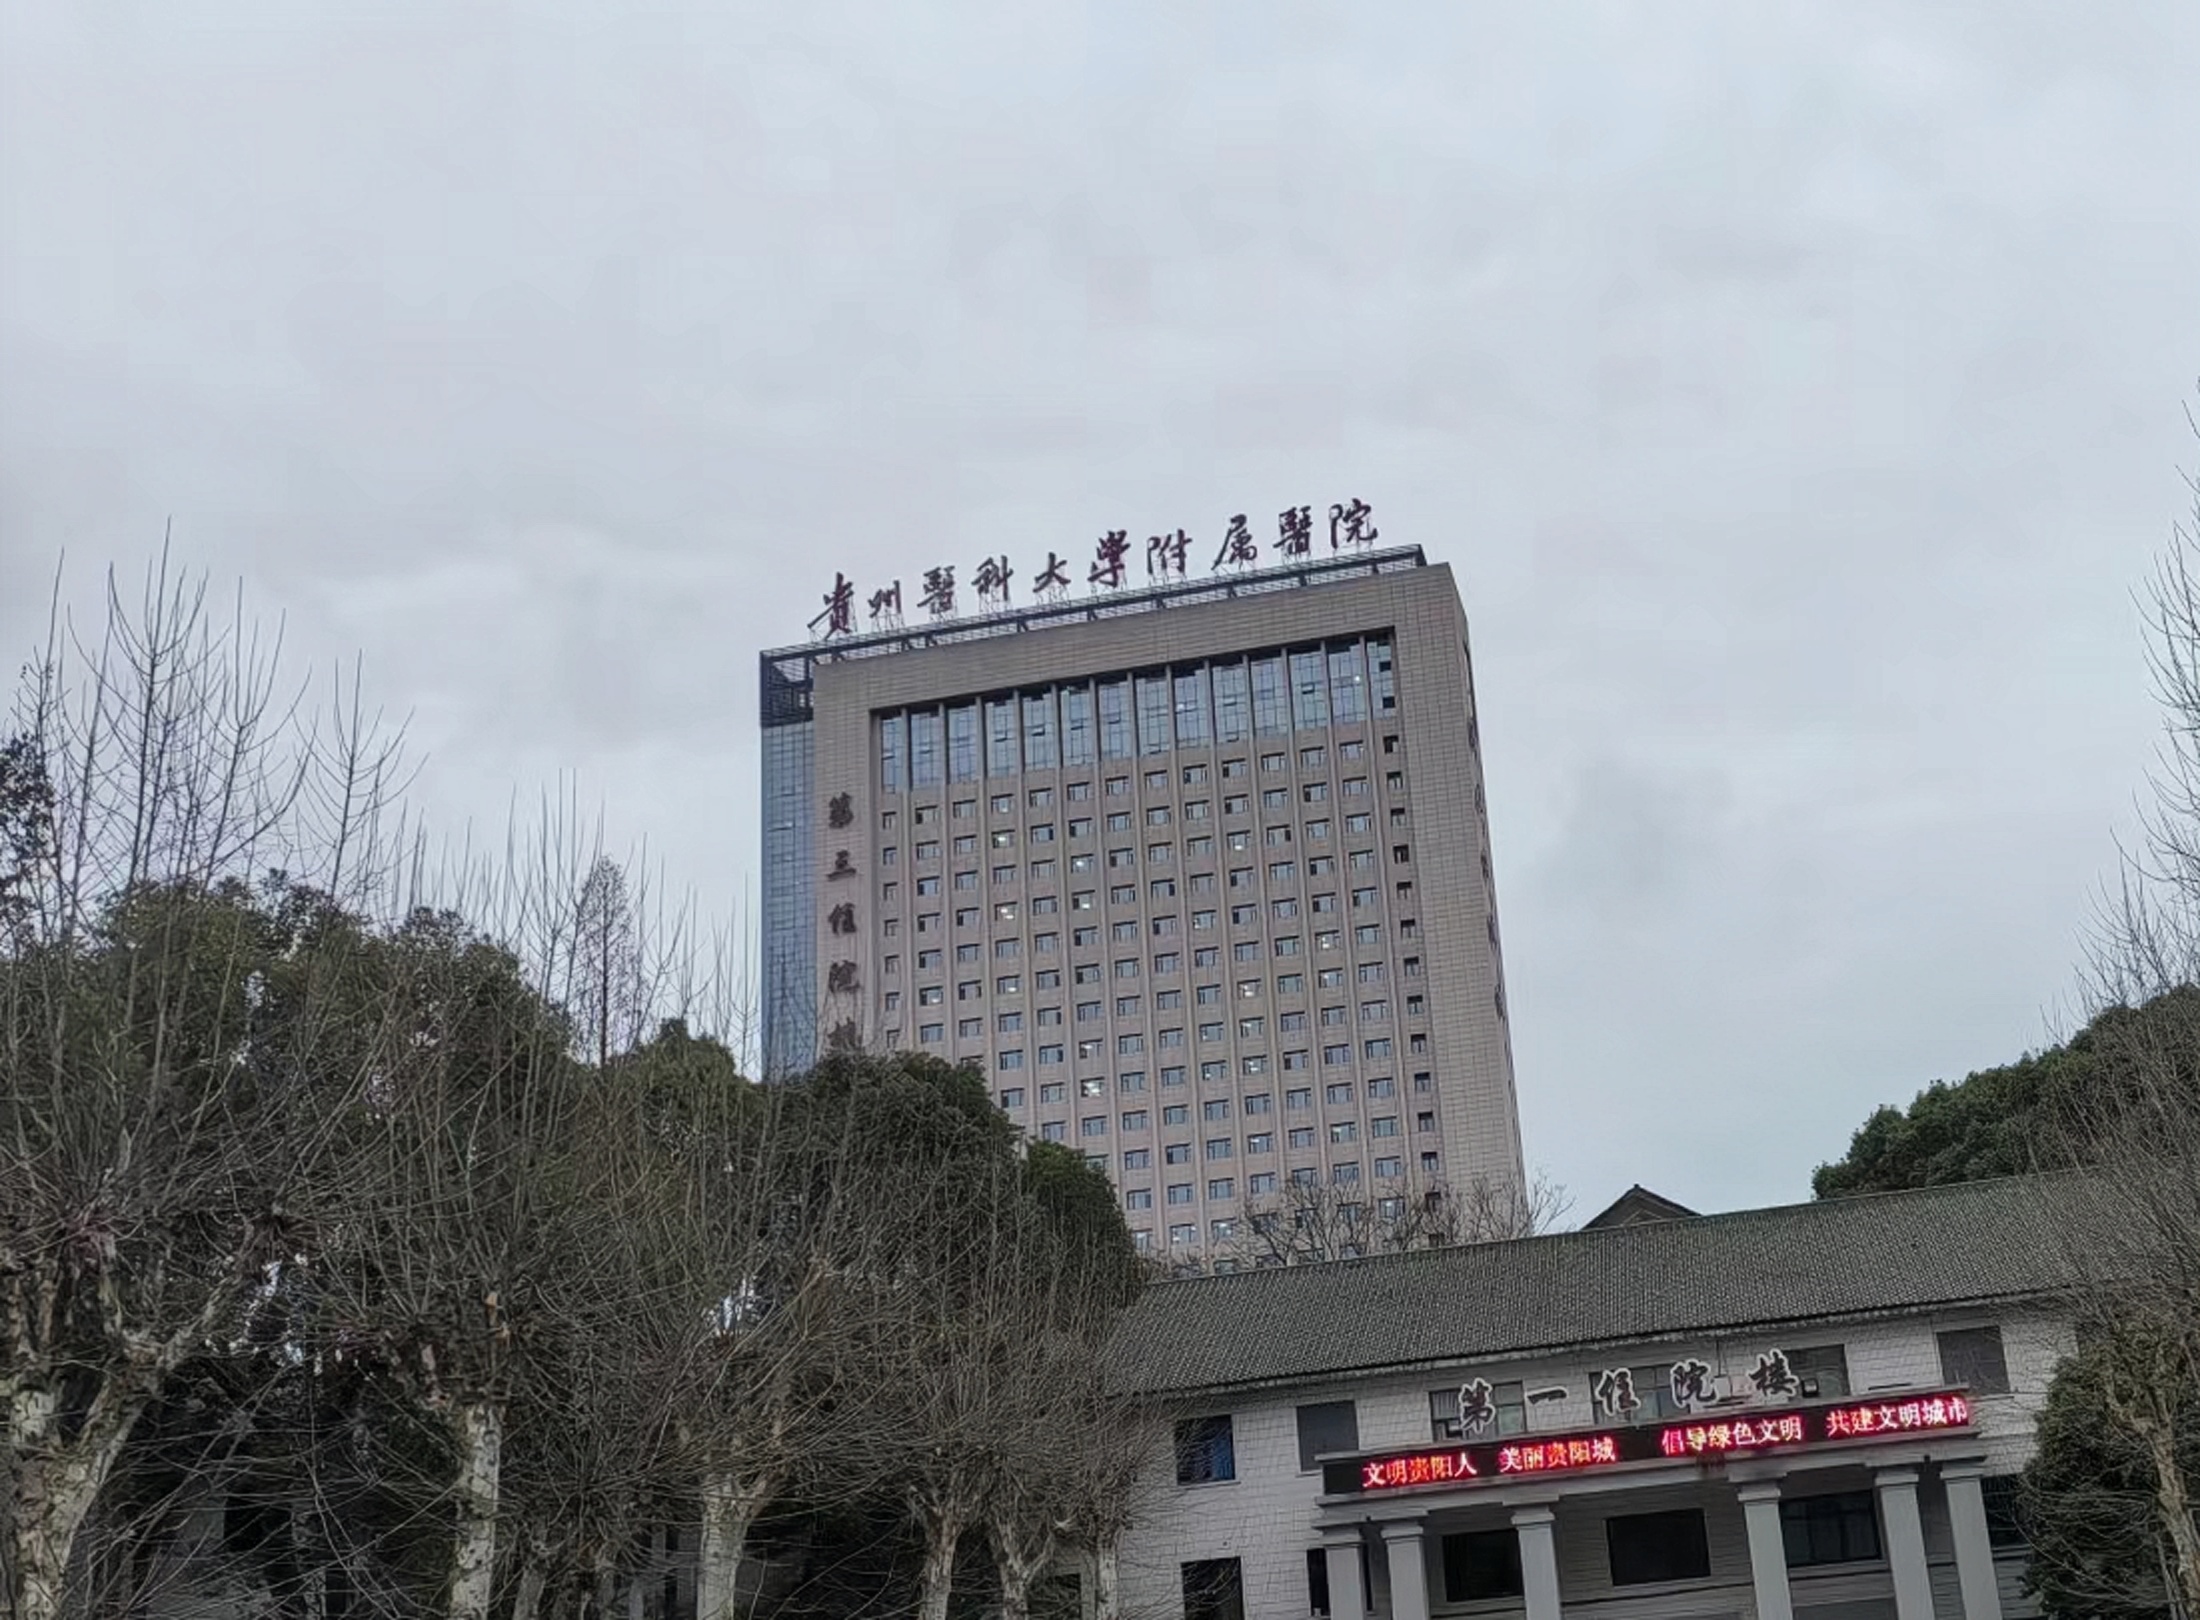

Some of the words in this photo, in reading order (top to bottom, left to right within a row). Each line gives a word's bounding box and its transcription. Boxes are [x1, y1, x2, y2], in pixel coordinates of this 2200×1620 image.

[1458, 1348, 1799, 1433] 第一住院楼
[1362, 1451, 1478, 1488] 文明贵阳人
[1500, 1436, 1617, 1474] 美丽贵阳城
[1662, 1416, 1803, 1456] 倡导绿色文明
[1826, 1396, 1967, 1436] 共建文明城市
